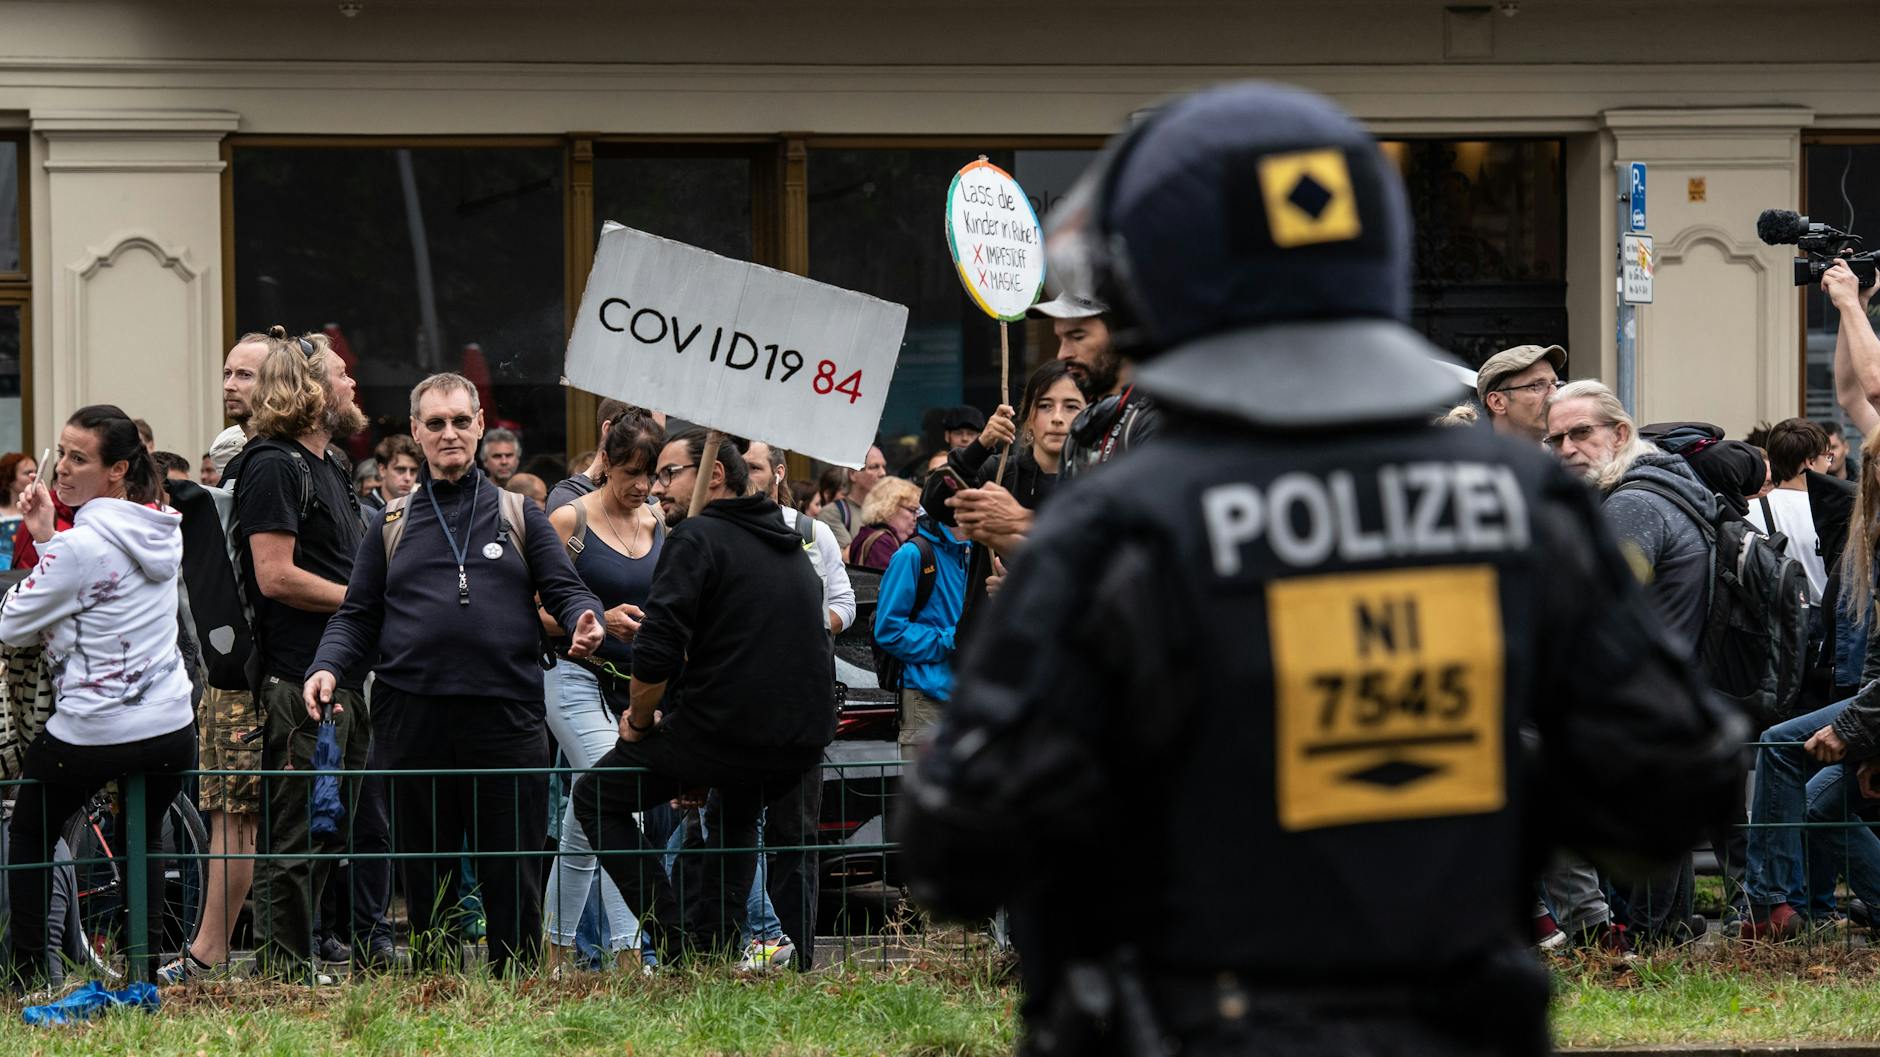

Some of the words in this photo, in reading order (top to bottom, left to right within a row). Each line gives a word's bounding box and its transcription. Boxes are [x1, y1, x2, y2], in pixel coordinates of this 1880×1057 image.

[960, 181, 994, 207] Lass
[998, 184, 1015, 211] die
[963, 209, 999, 236] Kinder
[1002, 221, 1011, 239] in
[986, 245, 1027, 269] IMPFSTOFF
[990, 270, 1024, 292] MASKE
[812, 359, 862, 404] 84
[1202, 460, 1530, 577] POLIZEI
[1354, 595, 1422, 656] NI
[1310, 661, 1472, 730] 7545
